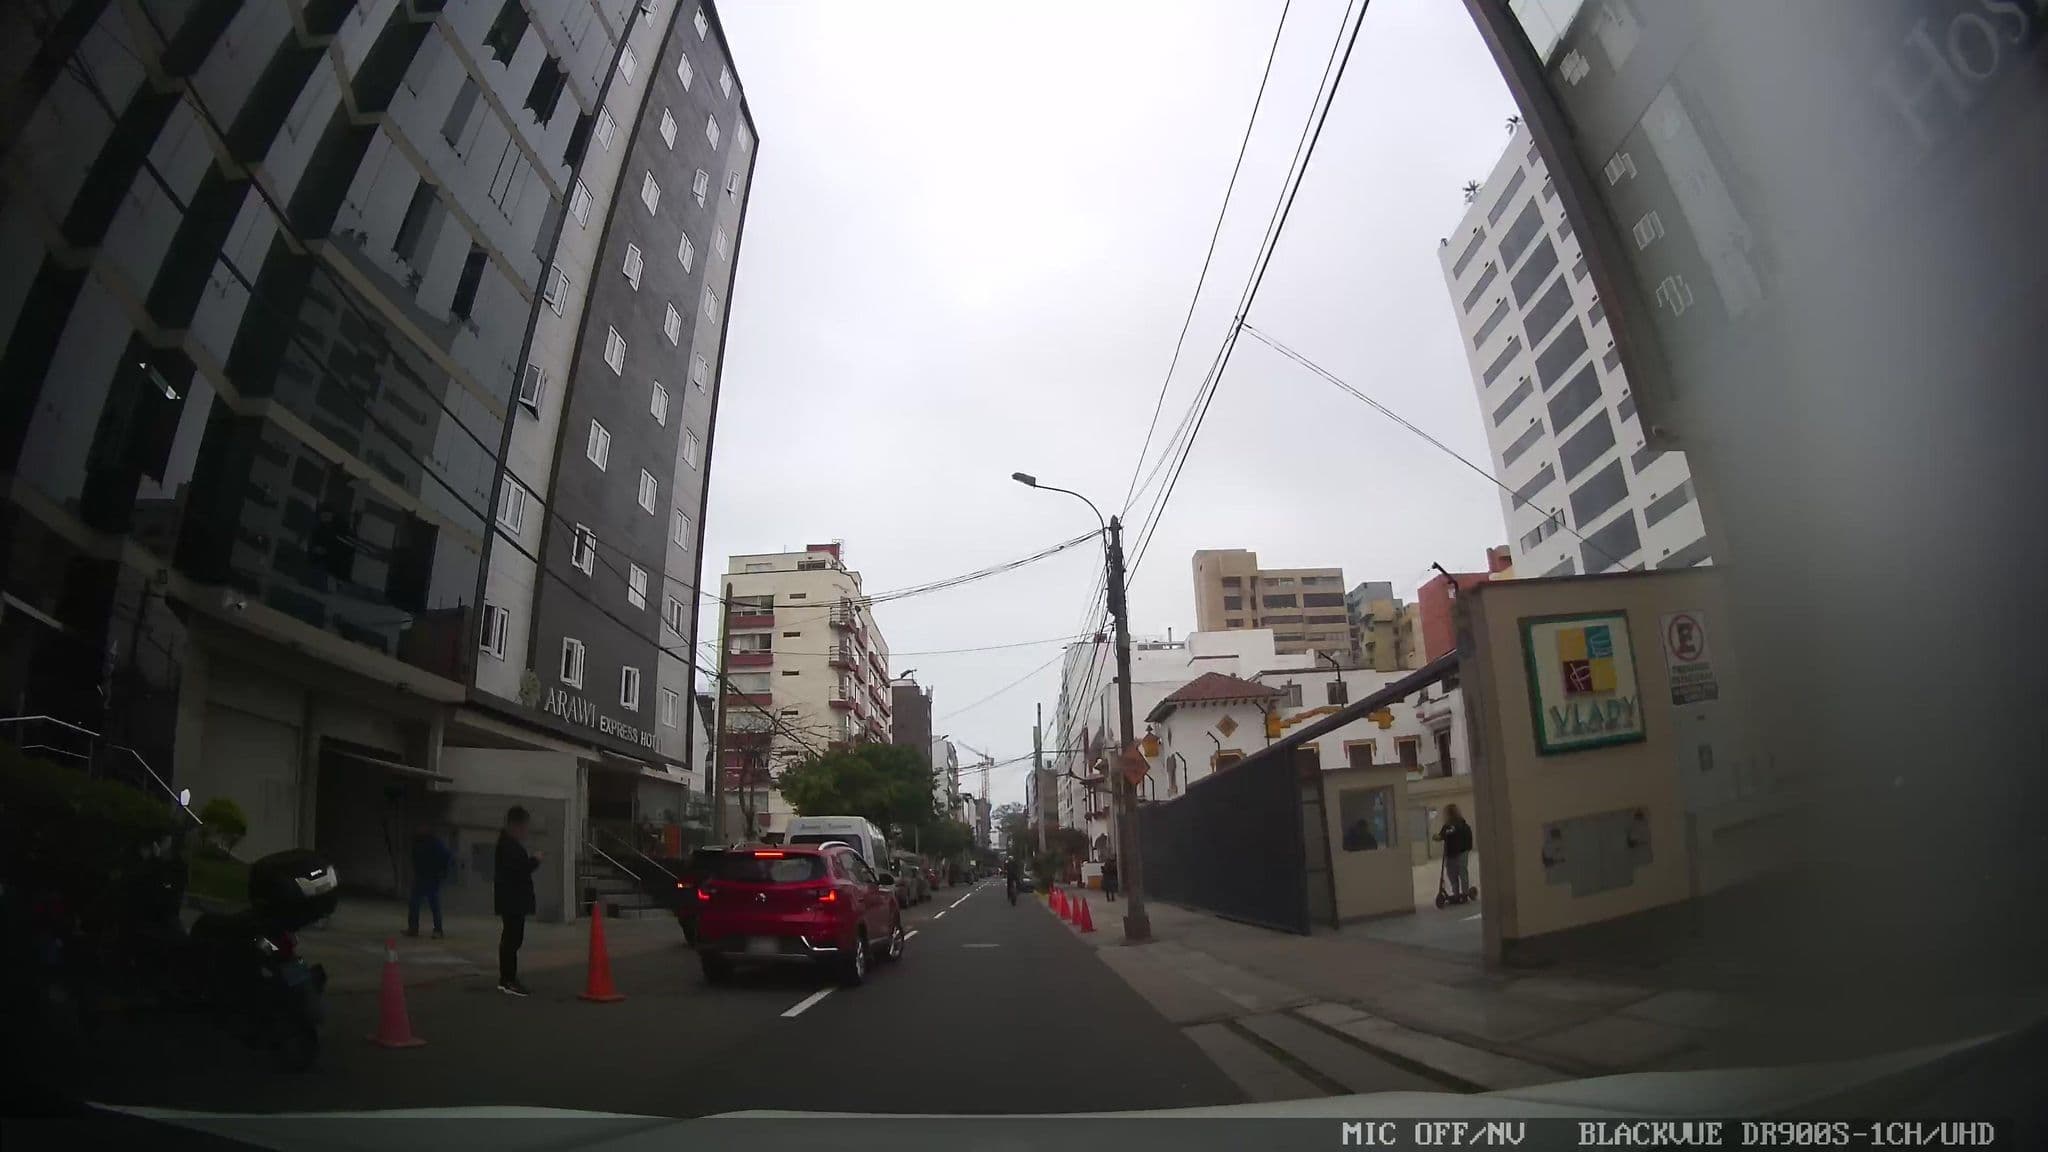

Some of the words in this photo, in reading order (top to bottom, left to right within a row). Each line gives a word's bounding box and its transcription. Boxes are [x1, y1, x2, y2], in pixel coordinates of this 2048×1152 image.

[544, 687, 597, 728] ARAWI
[600, 715, 639, 744] EXPRESS
[1550, 696, 1638, 736] VLADY
